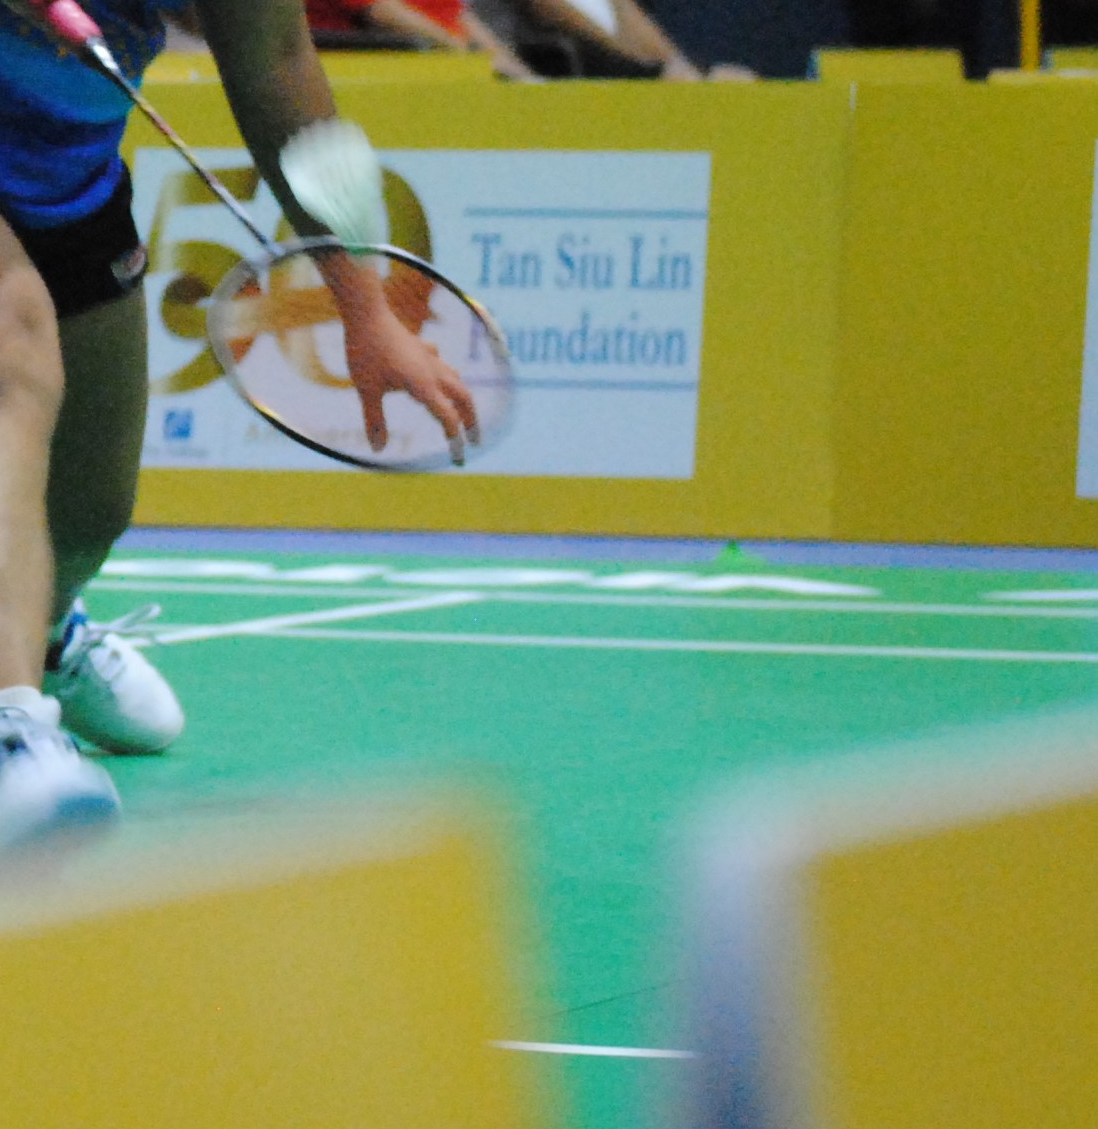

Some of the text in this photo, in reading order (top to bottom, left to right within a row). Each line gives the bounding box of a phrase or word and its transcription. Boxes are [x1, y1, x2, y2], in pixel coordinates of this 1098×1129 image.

[471, 232, 693, 290] Tan Siu Lin
